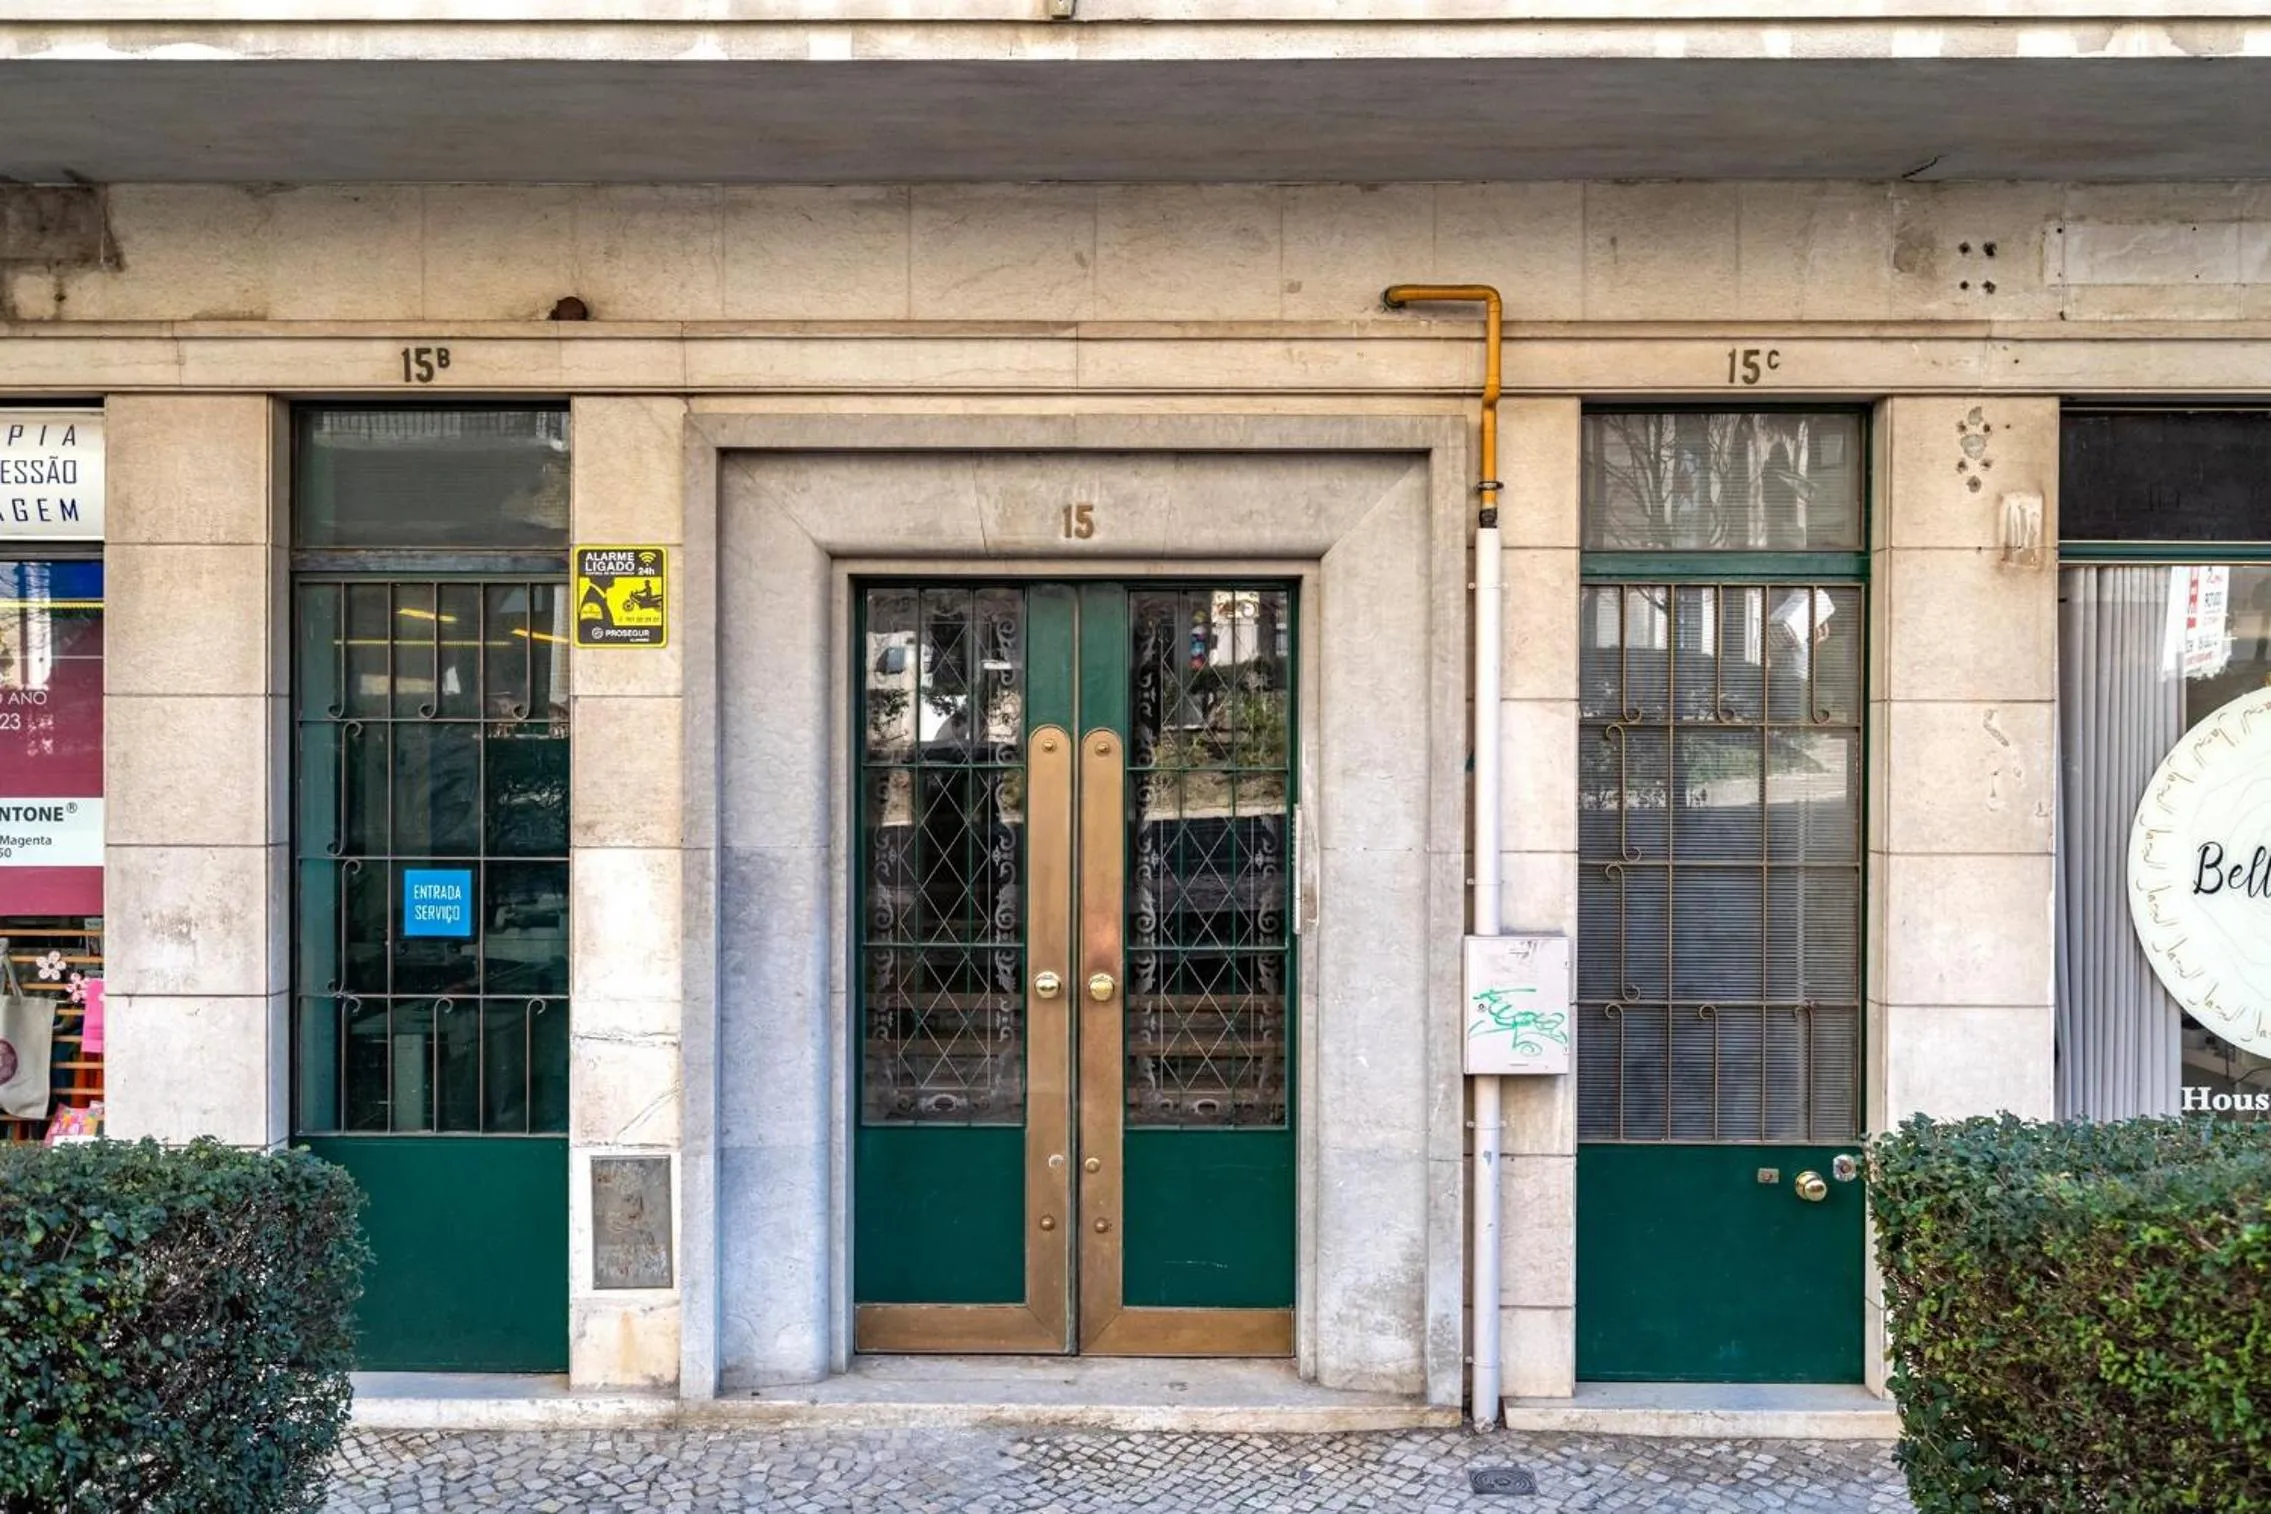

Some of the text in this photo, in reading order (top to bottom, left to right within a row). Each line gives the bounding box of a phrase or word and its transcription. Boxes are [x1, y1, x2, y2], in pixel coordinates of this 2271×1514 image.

[401, 347, 450, 383] 15B
[7, 424, 76, 446] PIA
[0, 456, 77, 484] ESSÃO
[1062, 504, 1095, 539] 15
[586, 552, 635, 561] ALARME
[585, 561, 635, 571] LIGADO
[638, 567, 655, 576] 24h
[605, 629, 649, 637] PROSEGUR
[8, 691, 47, 705] ANO
[0, 713, 21, 730] 23
[0, 835, 52, 848] Magenta
[413, 884, 462, 900] ENTRADA
[414, 904, 461, 924] SERVIÇO
